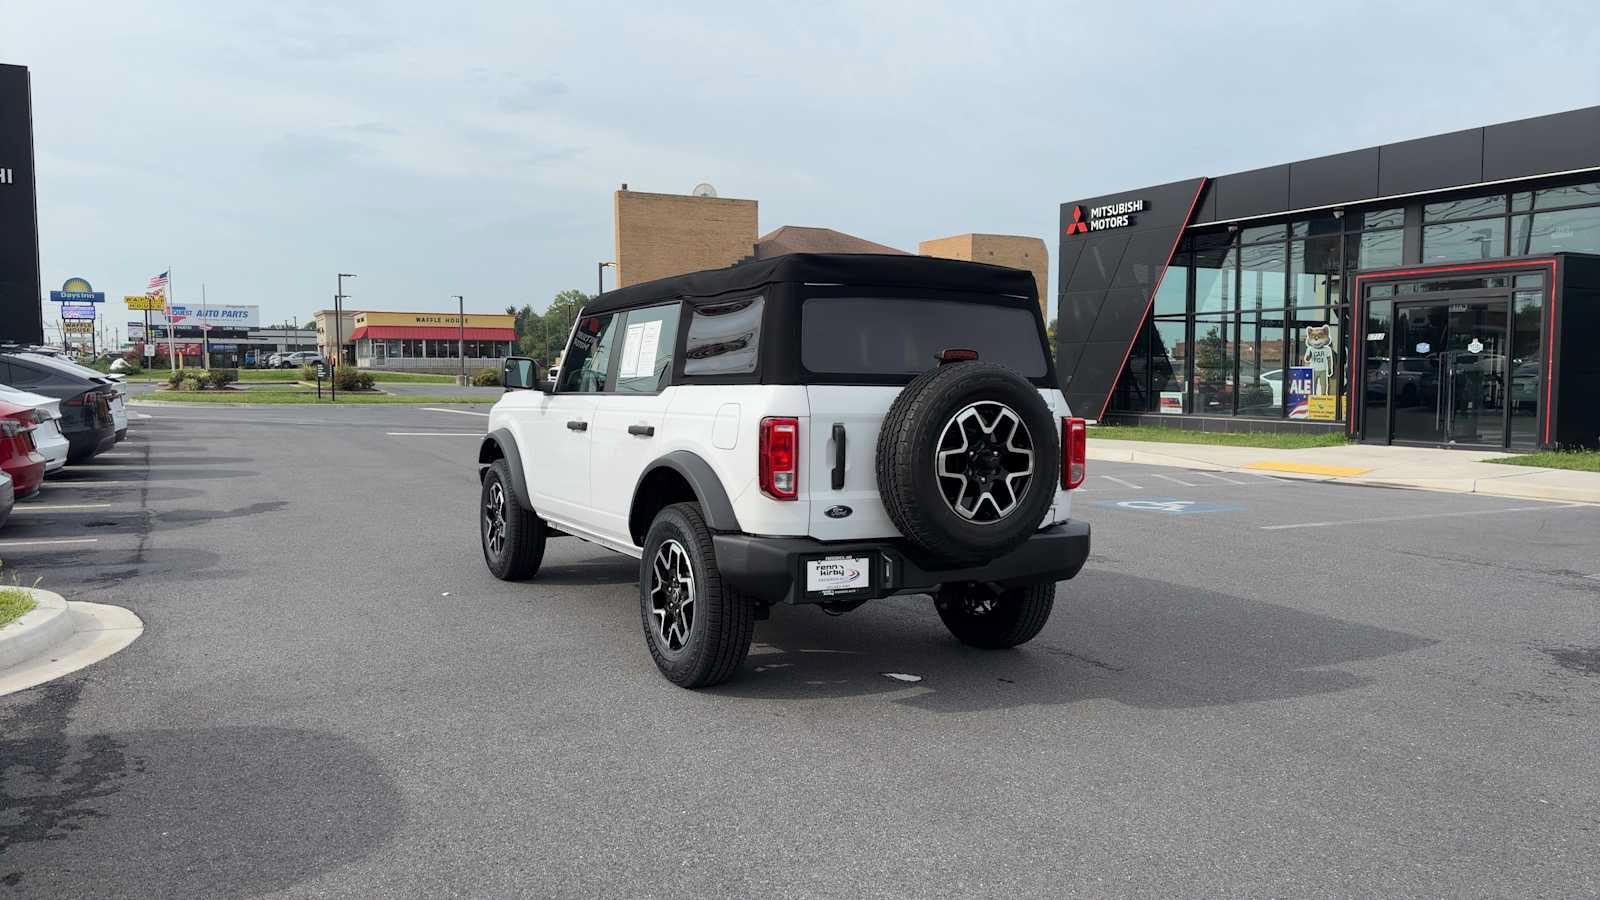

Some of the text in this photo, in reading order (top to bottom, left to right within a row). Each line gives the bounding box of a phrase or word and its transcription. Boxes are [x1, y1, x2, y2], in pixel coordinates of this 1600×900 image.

[1090, 199, 1143, 218] MITSUBISHI
[1090, 215, 1129, 231] MOTORS
[196, 309, 219, 318] AUTO
[221, 310, 248, 319] PARTS
[1289, 379, 1311, 394] ALE
